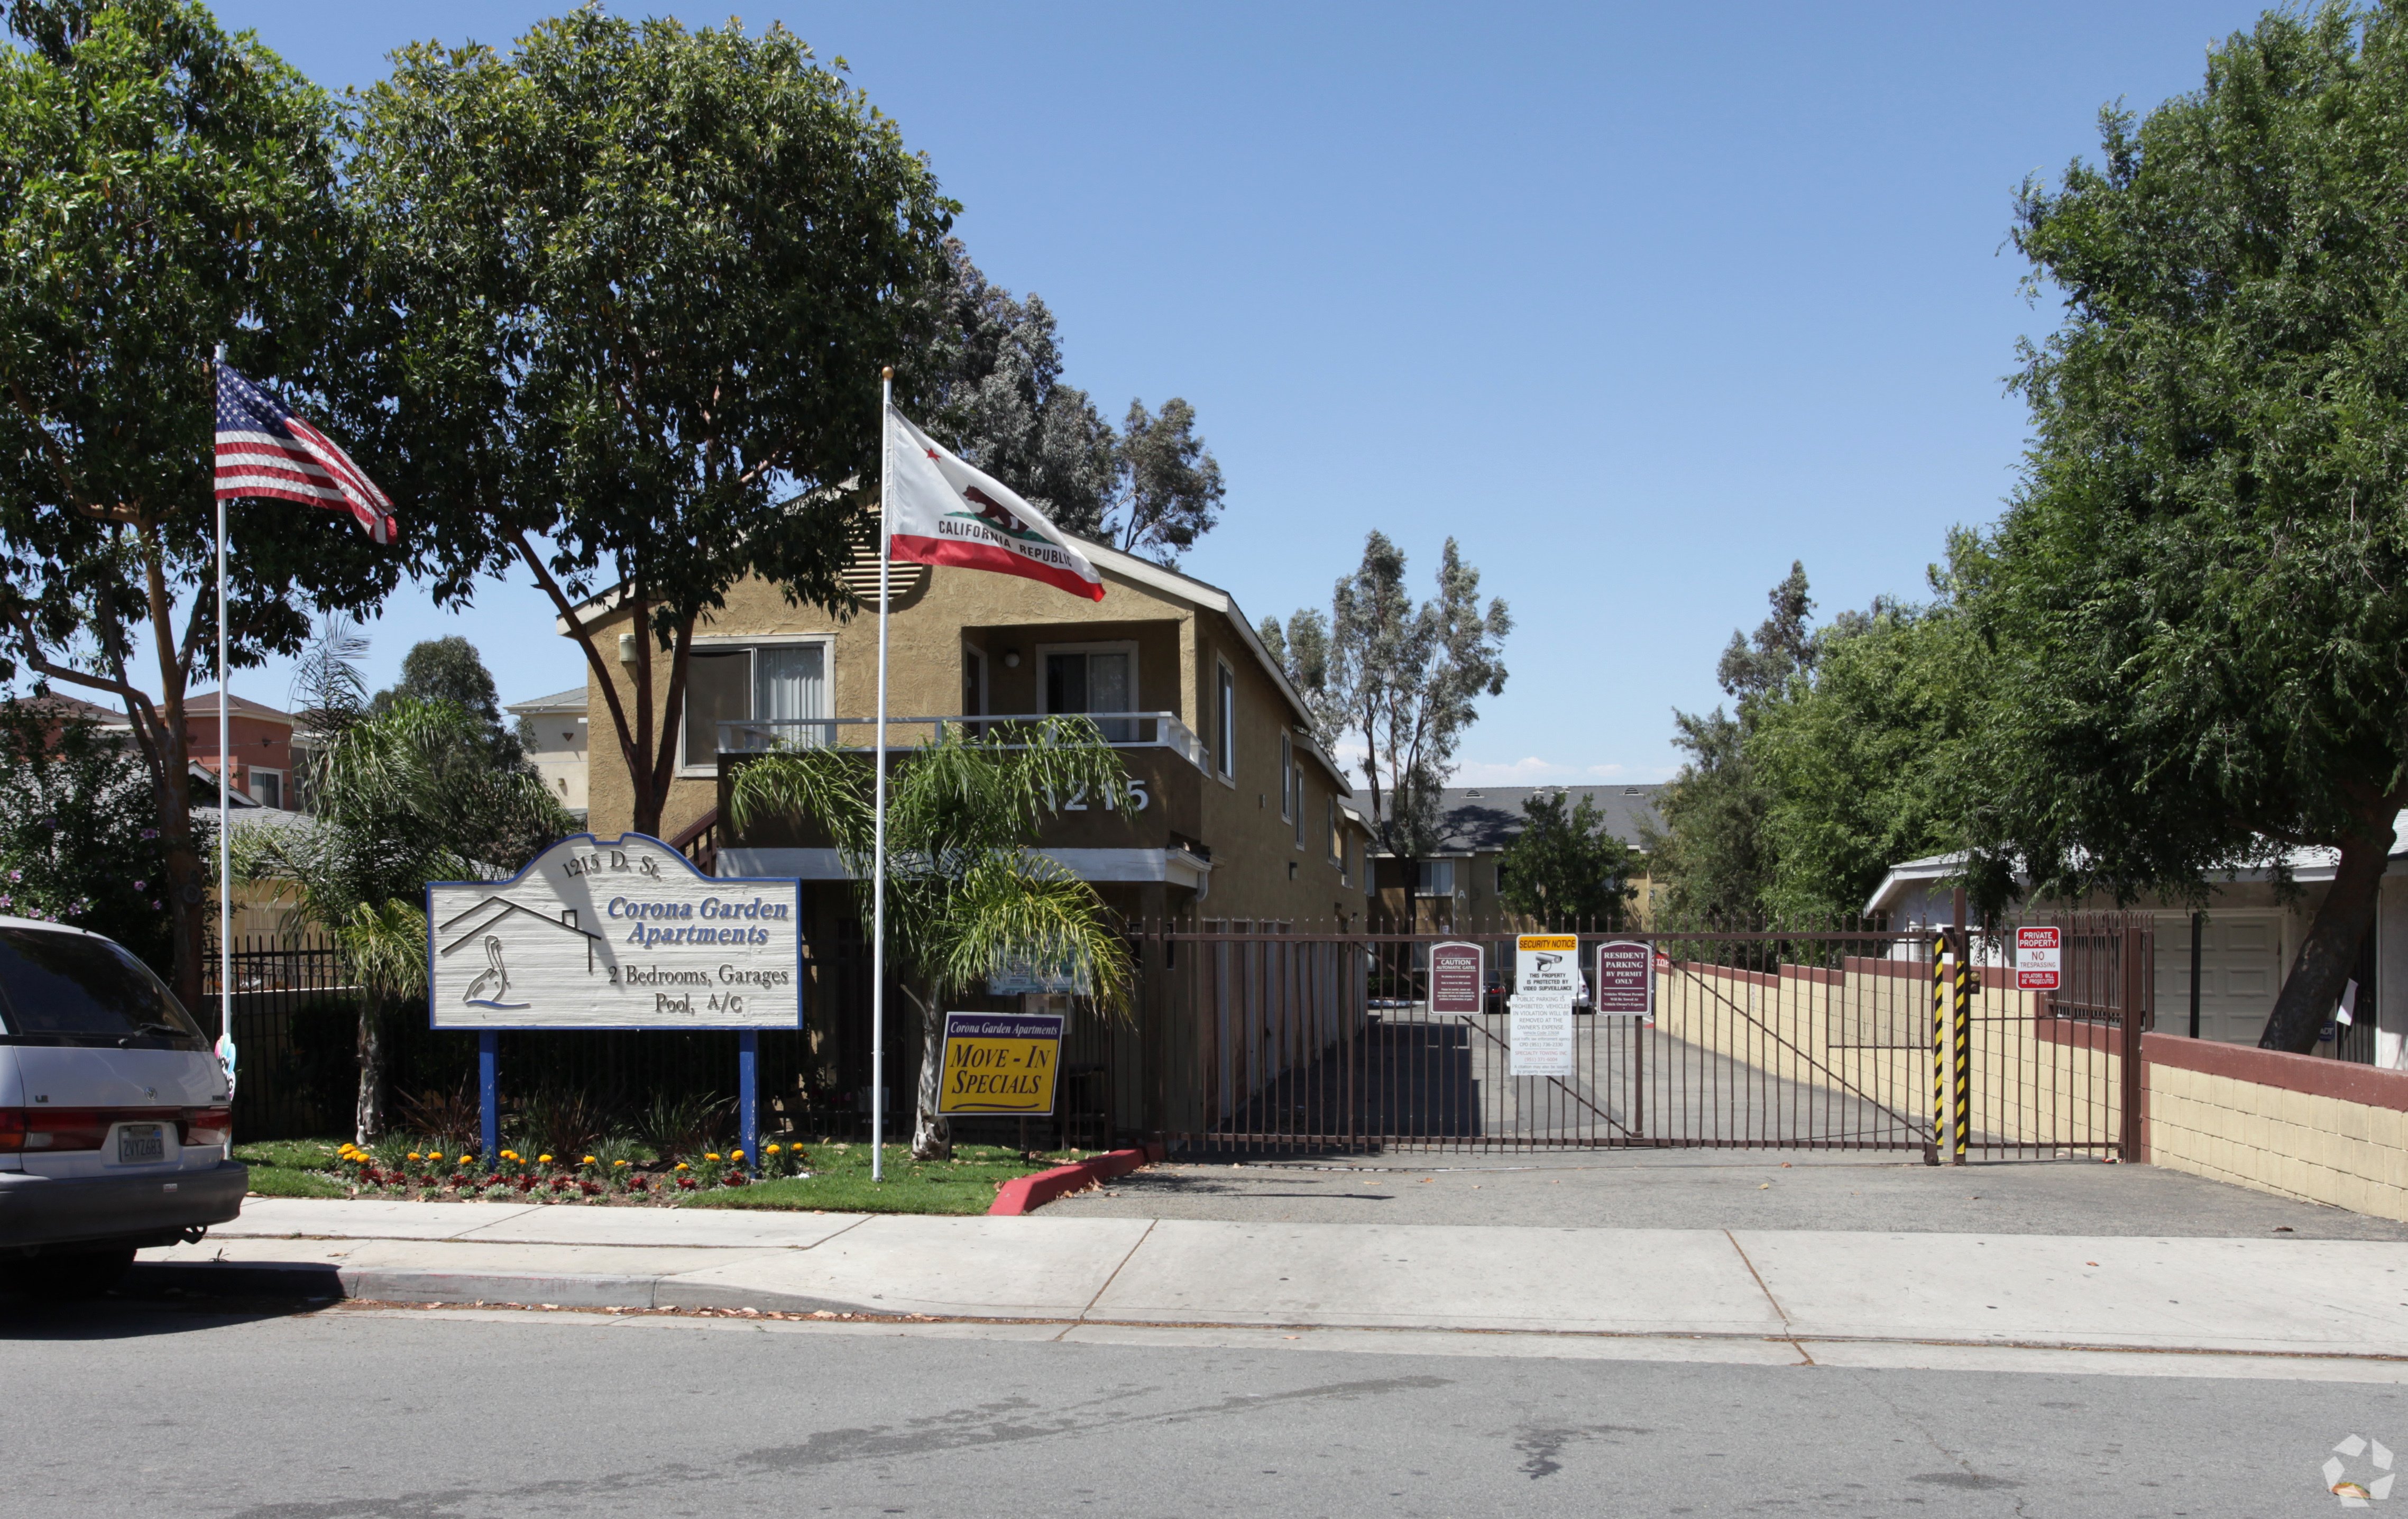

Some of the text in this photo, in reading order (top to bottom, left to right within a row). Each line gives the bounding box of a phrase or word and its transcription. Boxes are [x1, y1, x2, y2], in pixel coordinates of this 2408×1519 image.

[939, 520, 1072, 568] CALIFORNIA REPUBLIC
[1041, 780, 1149, 811] 1215
[562, 854, 600, 879] 1215
[610, 850, 629, 867] D.
[1458, 890, 1466, 899] A
[608, 896, 788, 919] Corona Garden
[627, 922, 769, 947] Apartments
[2032, 951, 2044, 960] NO
[609, 964, 788, 987] 2 Bedrooms, Garages
[656, 993, 694, 1014] Pool,
[950, 1022, 1058, 1037] Corona Garden Apartments
[952, 1070, 1042, 1094] SPECIALS
[124, 1139, 161, 1156] 2VYZ683
